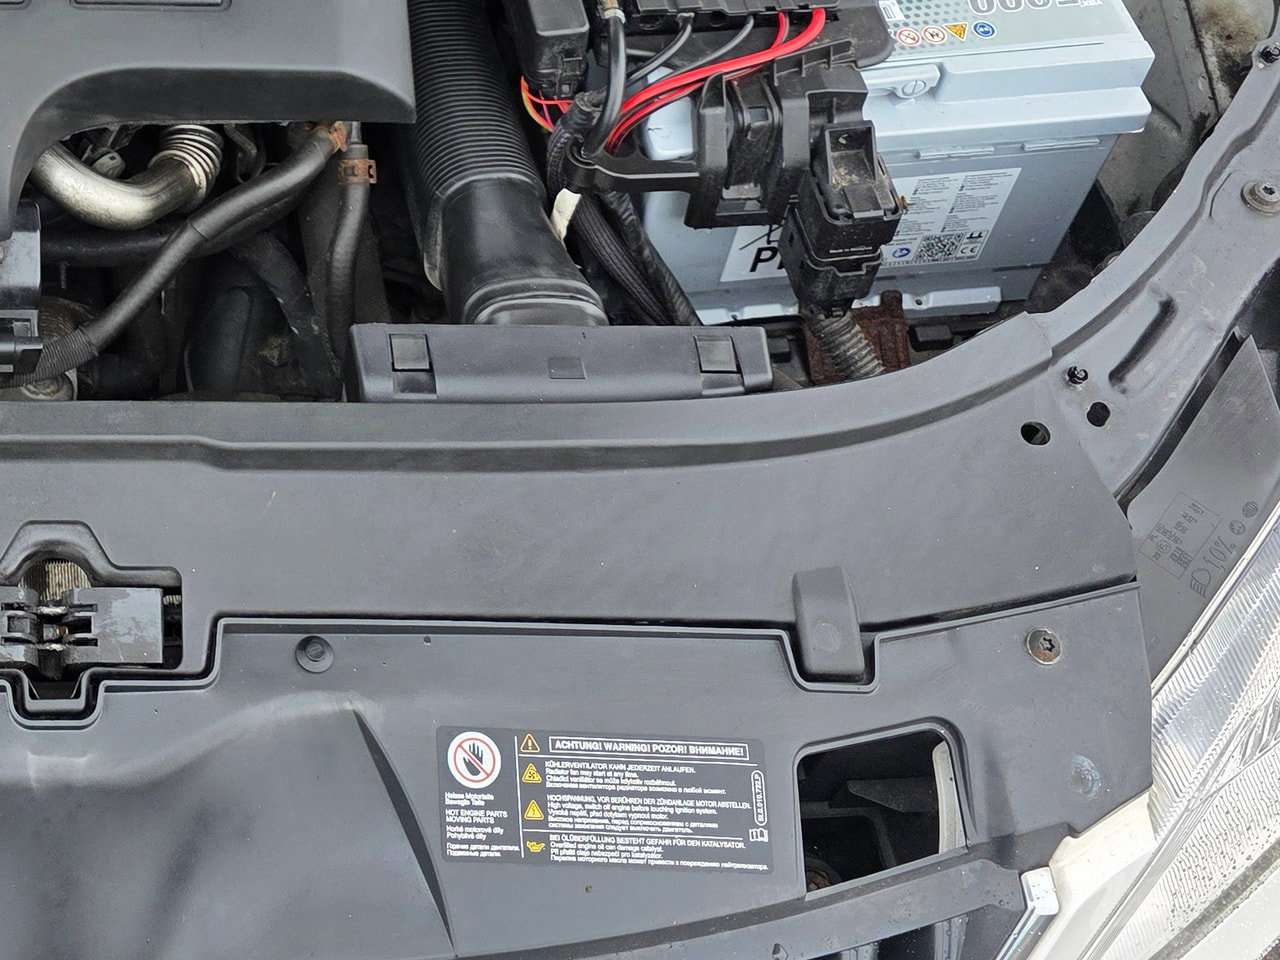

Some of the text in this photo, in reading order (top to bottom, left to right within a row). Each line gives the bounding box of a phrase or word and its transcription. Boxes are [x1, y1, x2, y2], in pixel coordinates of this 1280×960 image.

[555, 740, 687, 754] ACHTUNG! WARNING! POZOR!
[445, 808, 459, 816] HOT
[486, 810, 508, 818] PARTS
